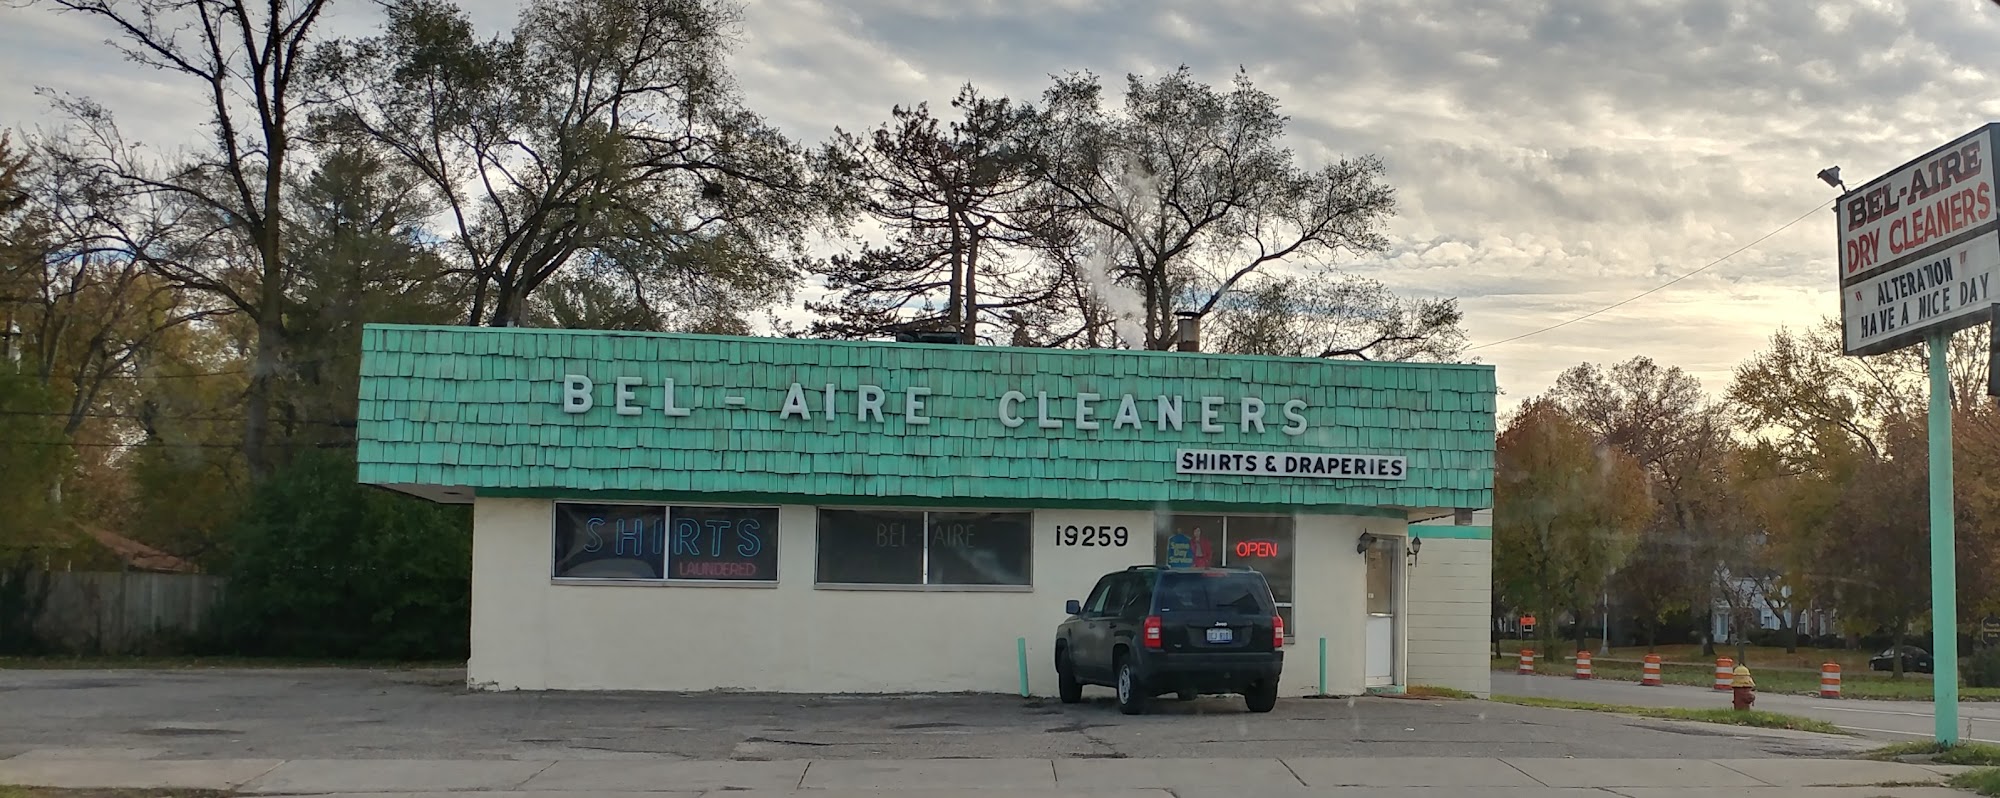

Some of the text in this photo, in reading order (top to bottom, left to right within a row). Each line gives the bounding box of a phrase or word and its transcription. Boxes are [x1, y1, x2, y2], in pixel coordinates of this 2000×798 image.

[1847, 140, 1983, 232] BEL-AIRE
[1846, 181, 1991, 274] DRY CLEANERS
[1877, 257, 1954, 307] ALTERATION
[1861, 272, 1990, 339] HAVE A NICE DAY
[999, 390, 1310, 436] CLEANERS
[1182, 452, 1403, 476] SHIRTS & DRAPERIES
[583, 517, 761, 557] SHIRTS
[1055, 525, 1129, 547] 19259
[1236, 541, 1278, 557] OPEN
[679, 562, 757, 577] LAUNDERED
